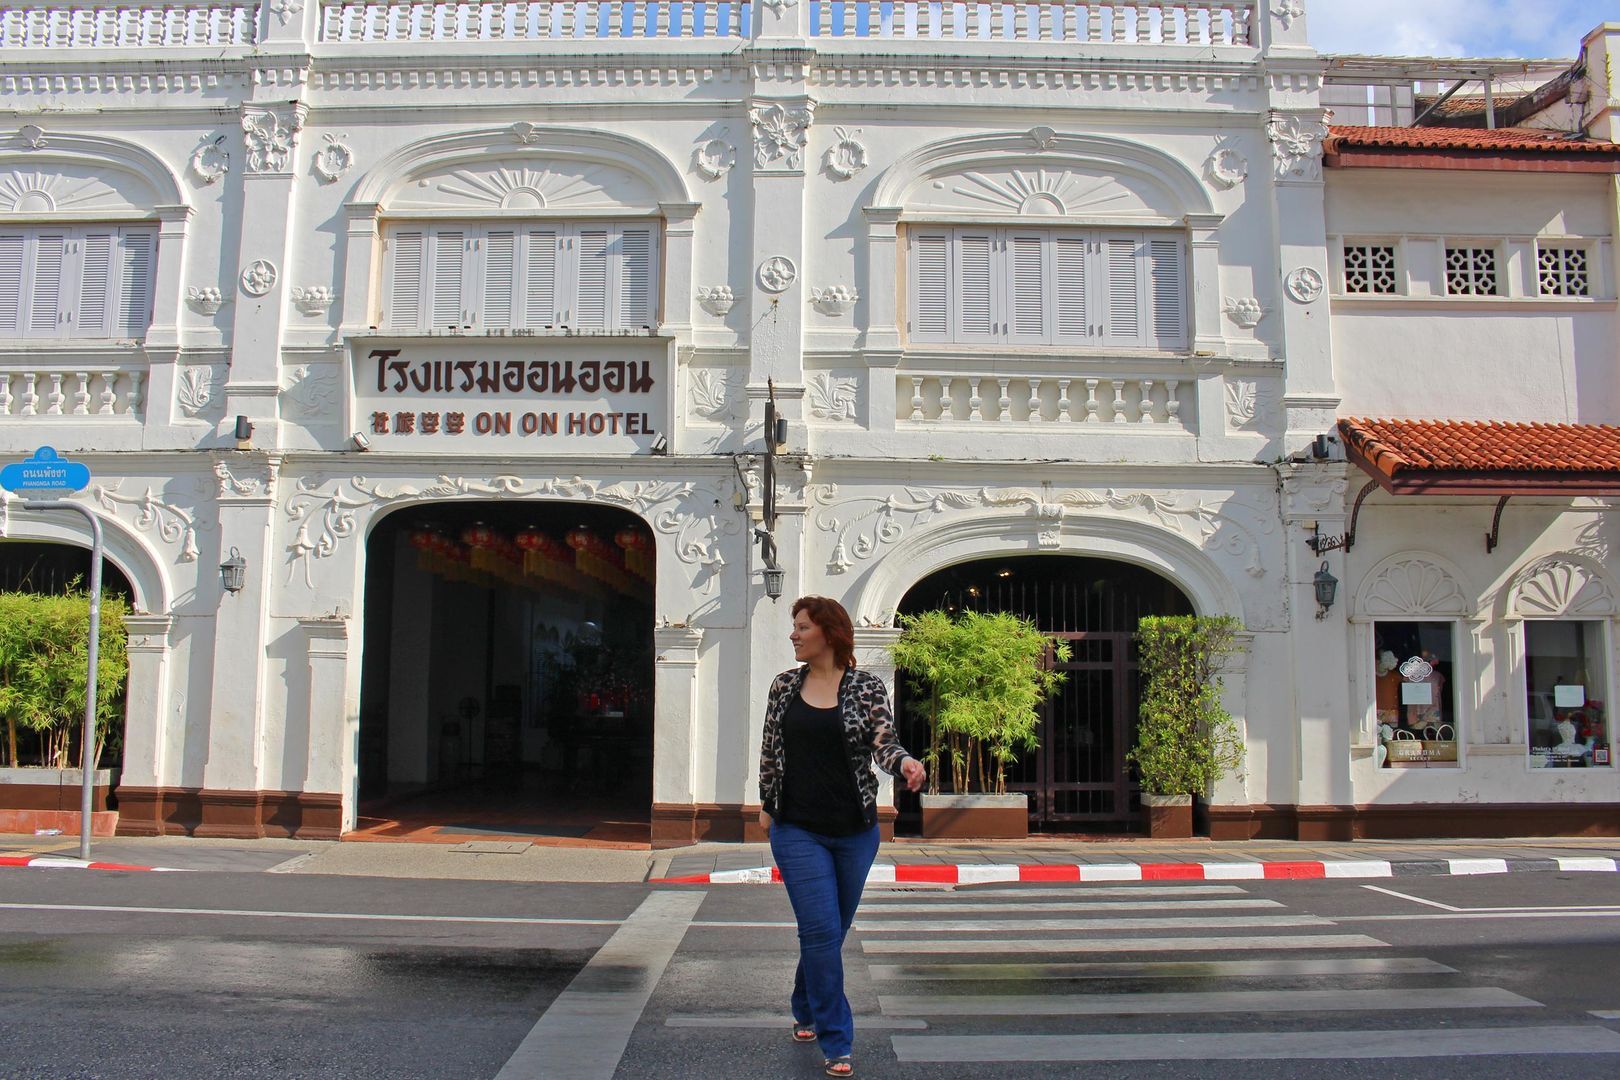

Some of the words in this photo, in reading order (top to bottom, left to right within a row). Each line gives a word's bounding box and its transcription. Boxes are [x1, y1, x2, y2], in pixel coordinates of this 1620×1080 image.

[476, 411, 511, 434] ON
[522, 411, 559, 434] ON
[568, 411, 655, 435] HOTEL
